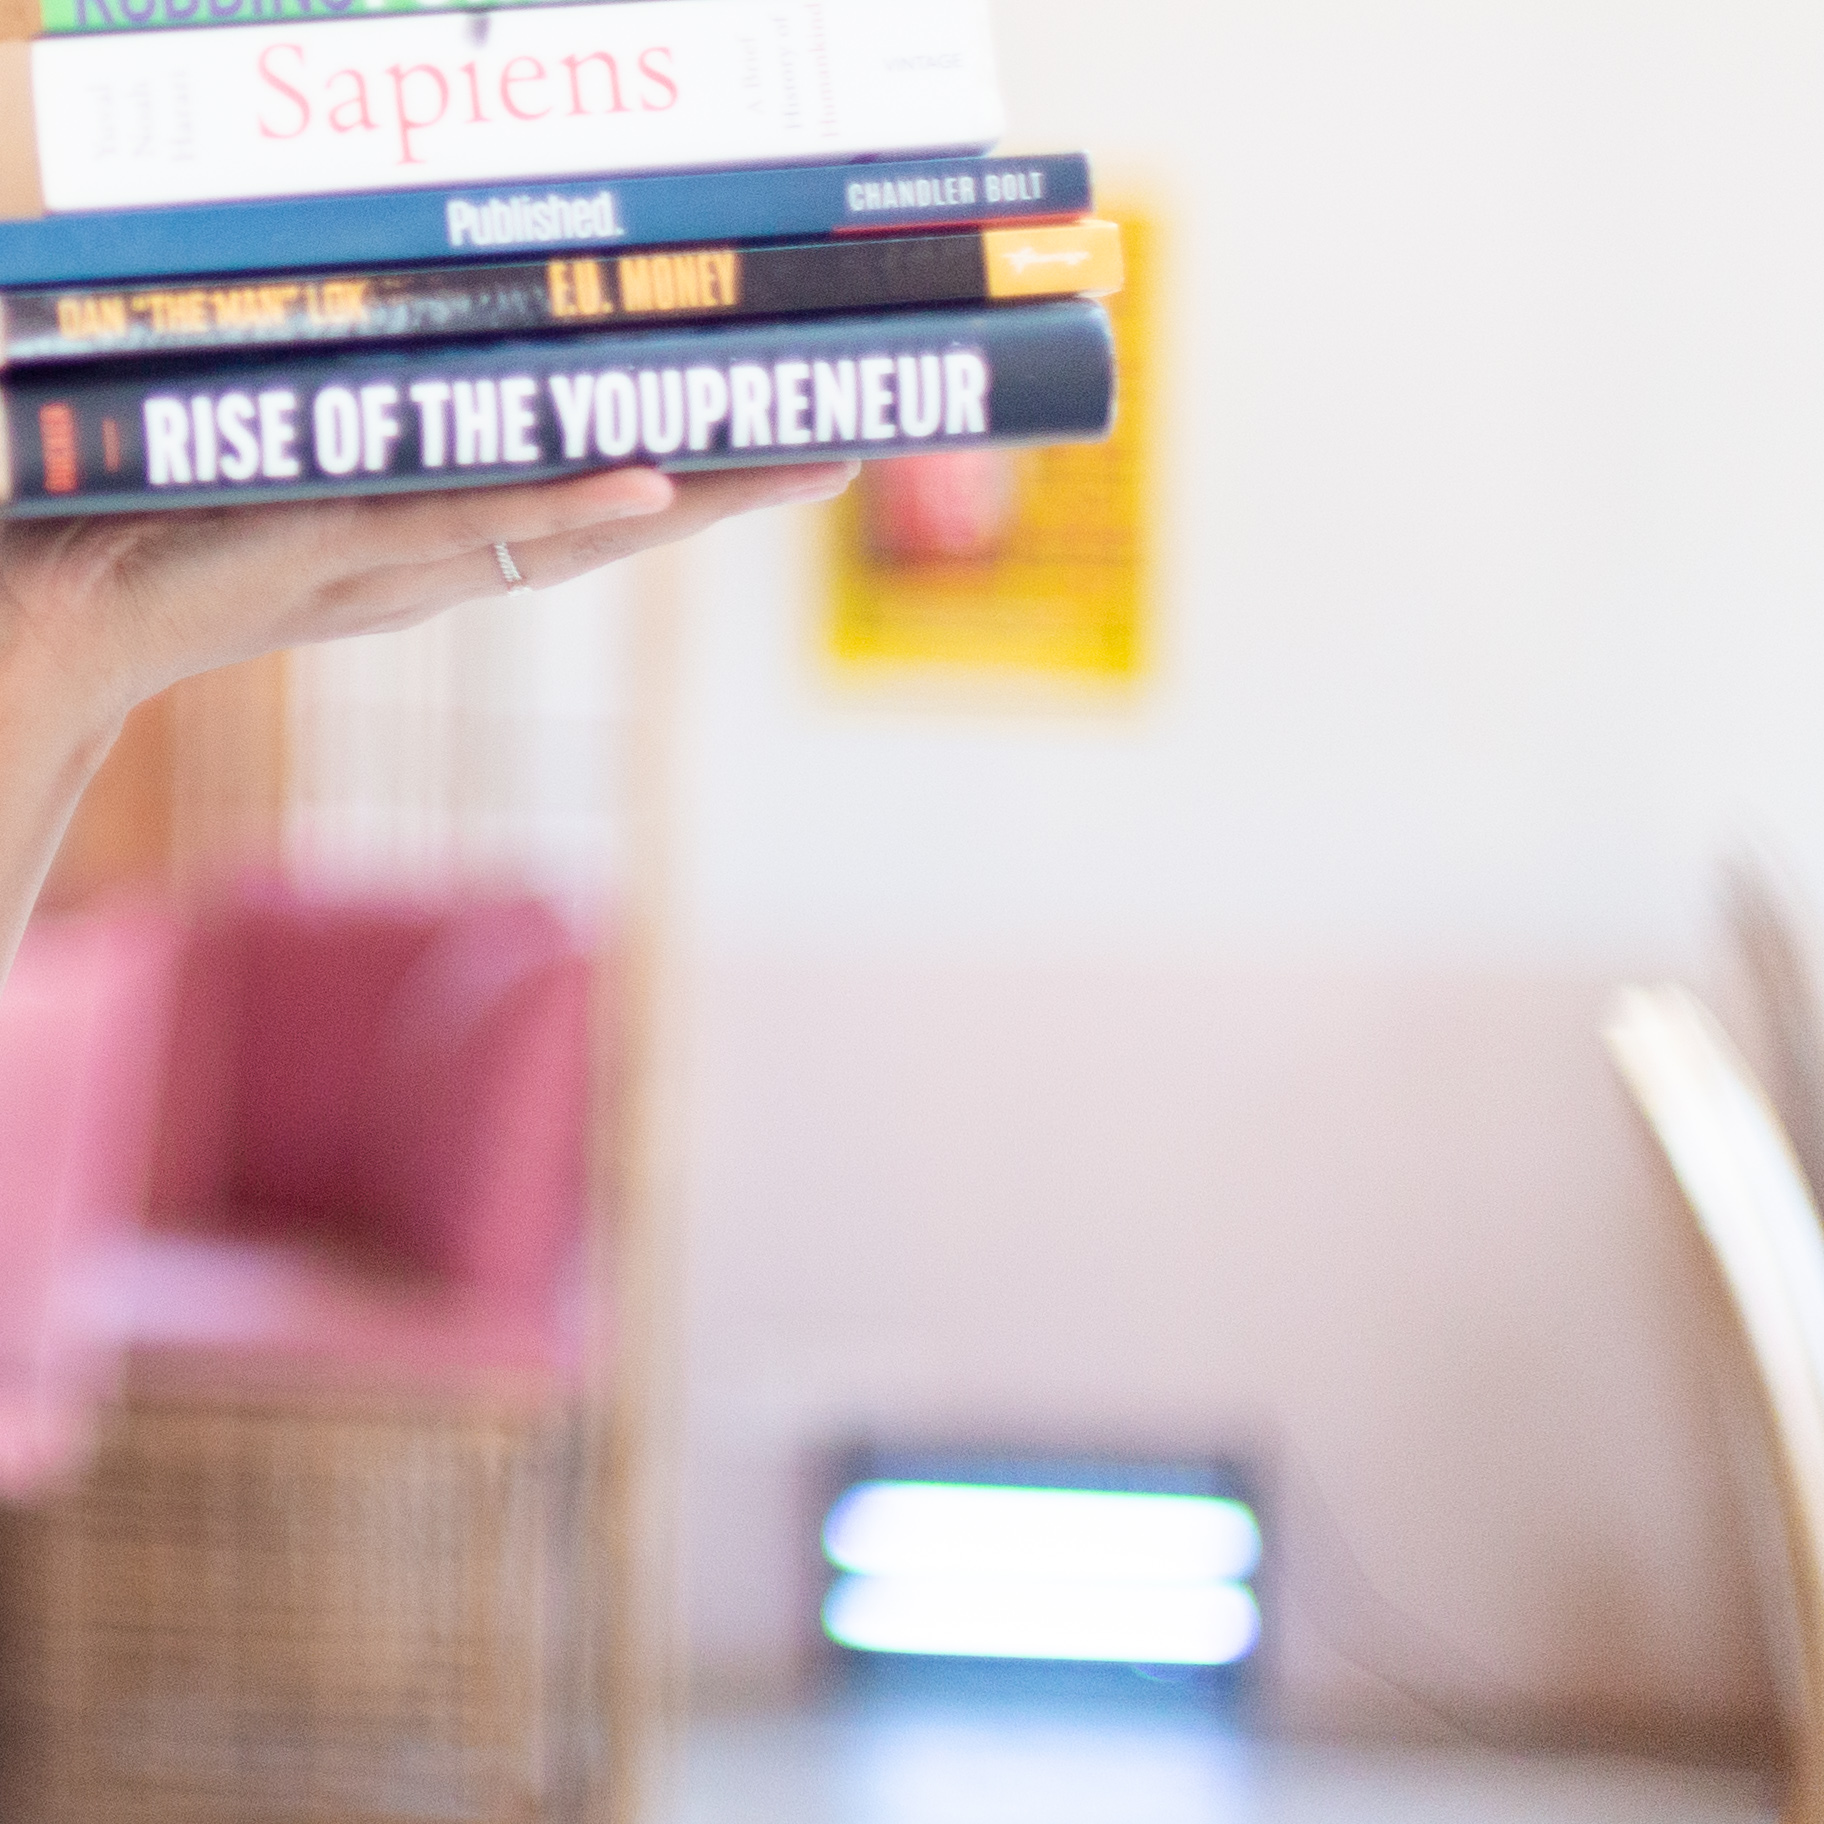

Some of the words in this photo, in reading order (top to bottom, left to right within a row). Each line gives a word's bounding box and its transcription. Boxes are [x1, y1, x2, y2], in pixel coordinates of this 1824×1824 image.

[804, 3, 838, 137] Humankind
[882, 52, 965, 72] VINTAGE
[255, 42, 679, 164] Sapiens
[447, 190, 625, 247] Published.
[848, 173, 975, 212] CHANDLER
[985, 171, 1044, 202] BOLT
[57, 294, 127, 340] DAN
[306, 280, 371, 325] LOK
[617, 250, 740, 312] MONEY
[142, 389, 300, 486] RISE
[313, 385, 401, 475] OF
[410, 377, 541, 468] THE
[551, 350, 989, 459] YOUPRENEUR
